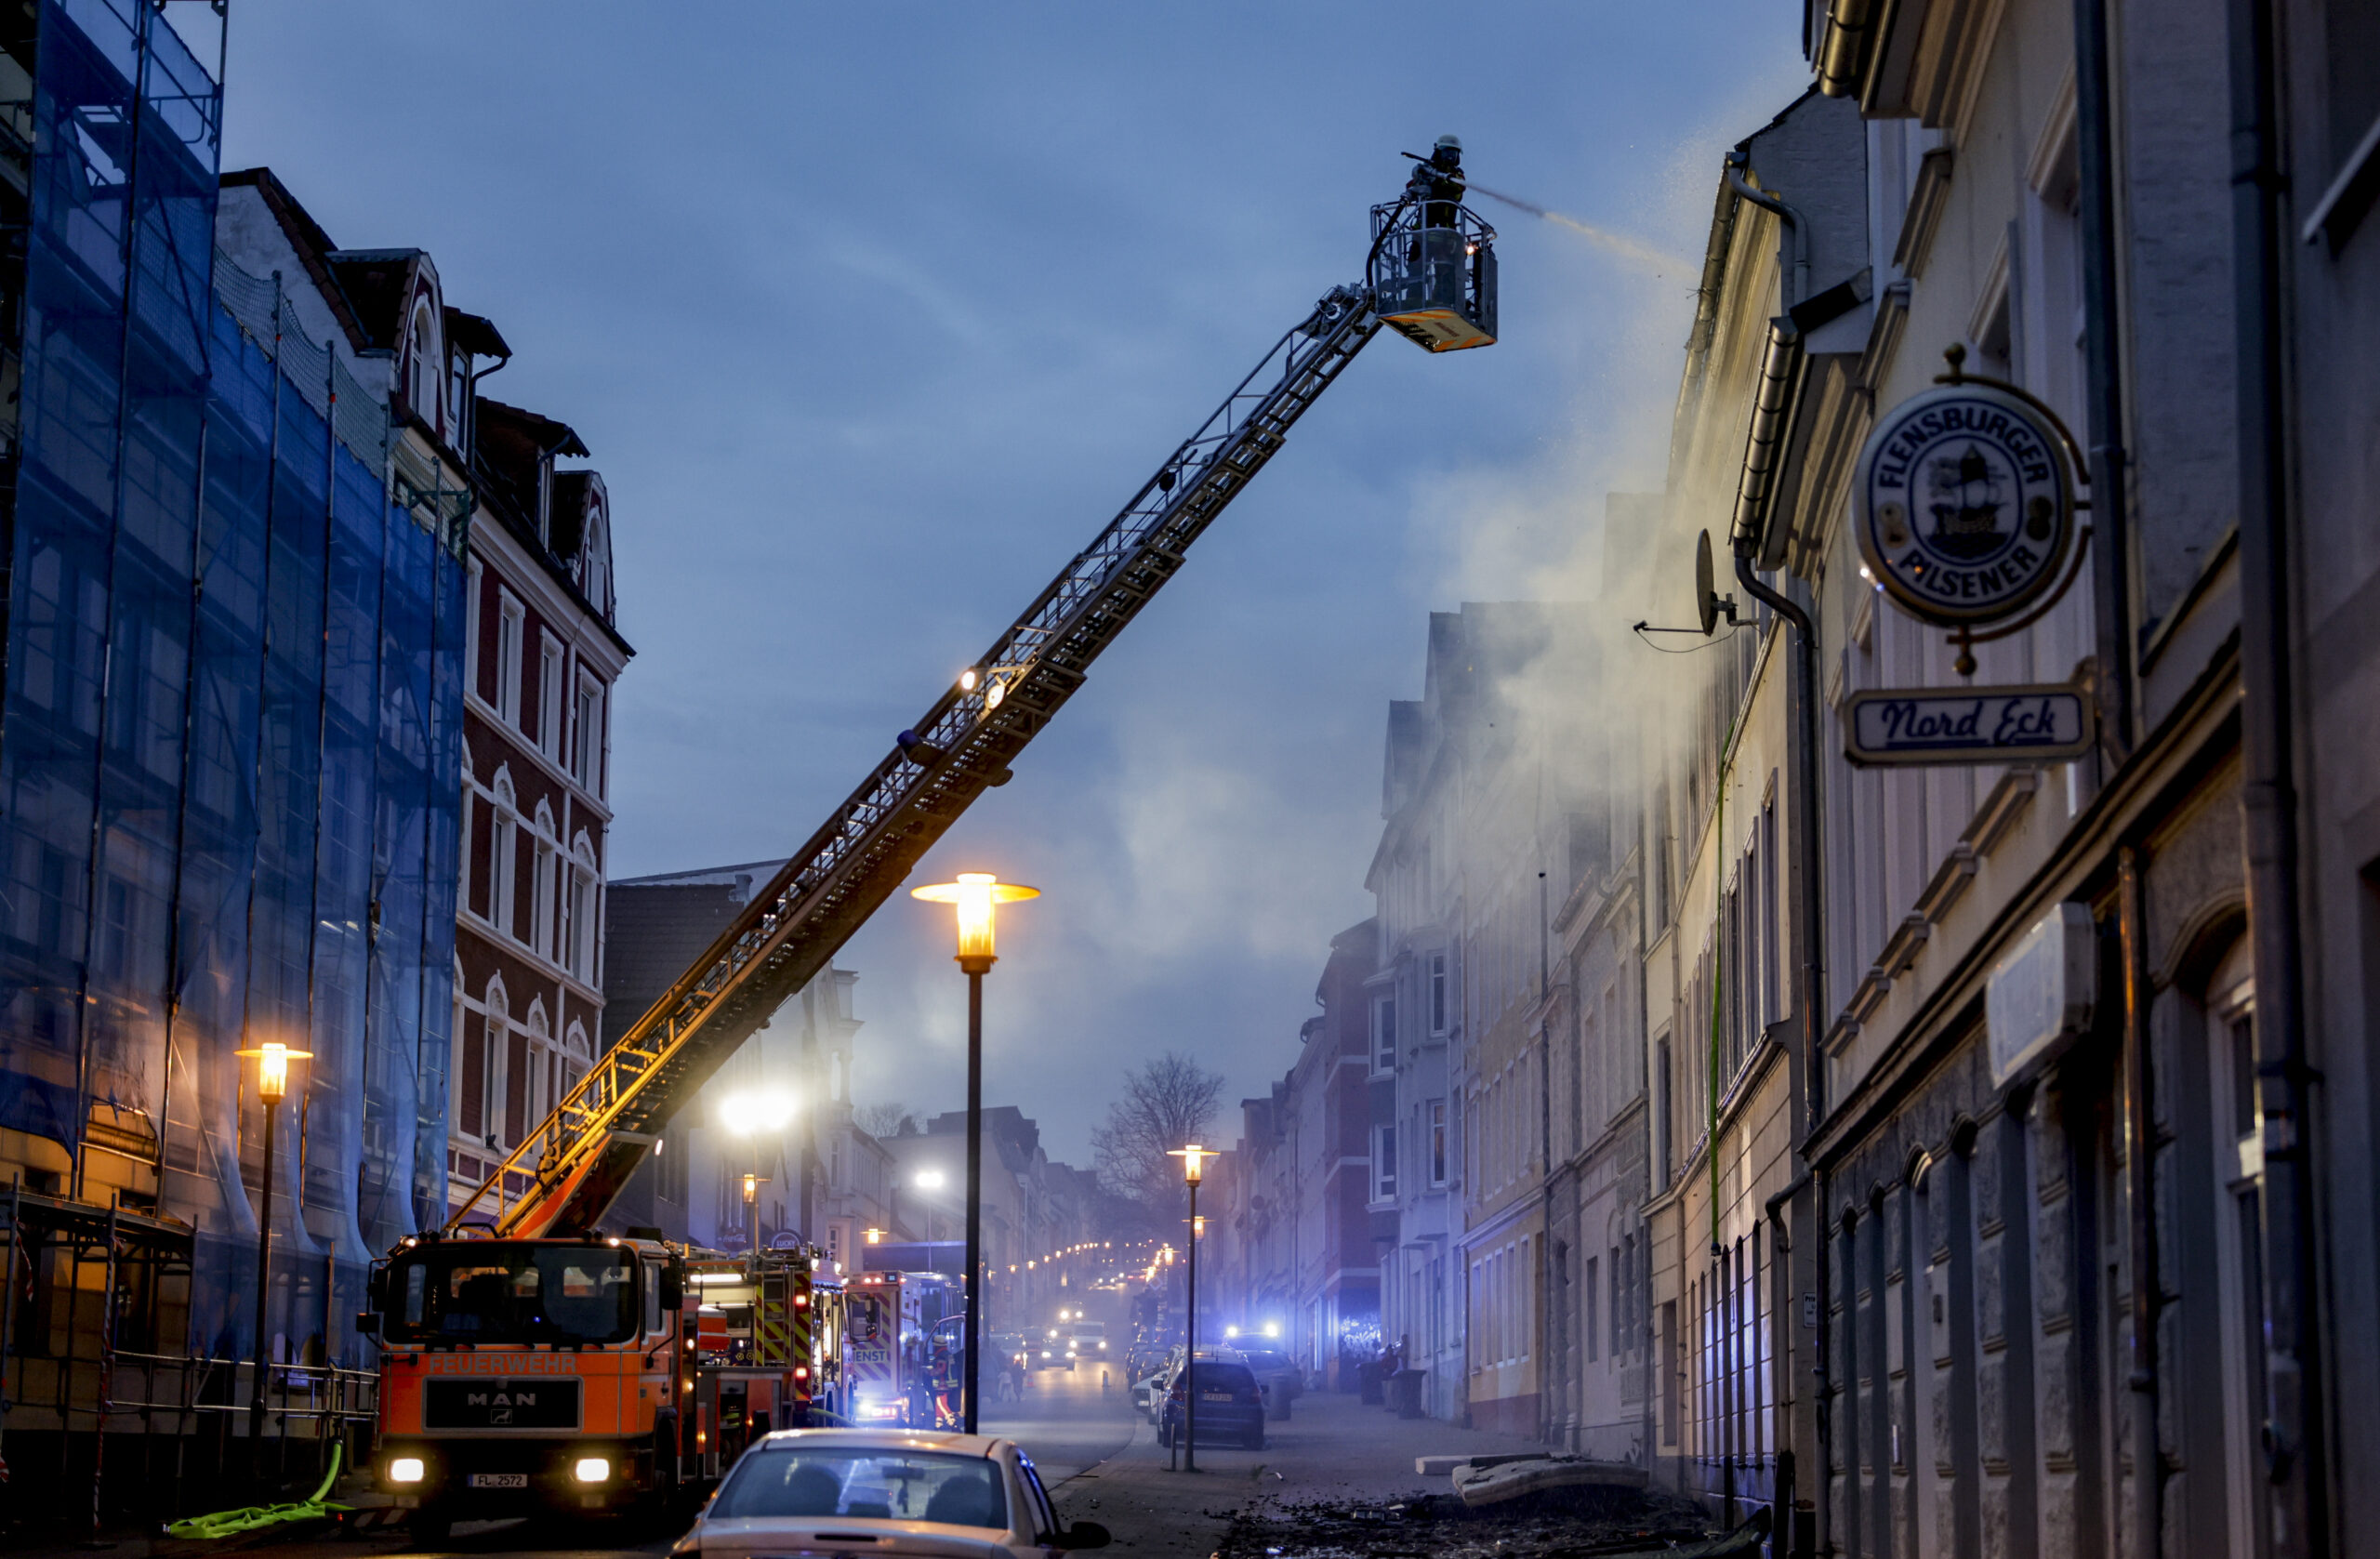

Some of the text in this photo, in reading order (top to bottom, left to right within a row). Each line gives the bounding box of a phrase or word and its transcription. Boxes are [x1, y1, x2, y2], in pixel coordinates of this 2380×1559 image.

[1879, 407, 2049, 488] FLENSBURGER
[1899, 546, 2038, 598] PILSENER
[1882, 698, 2055, 746] Nord Eck
[430, 1355, 577, 1373] FEUERWEHR
[467, 1393, 536, 1407] MAN
[478, 1475, 522, 1486] FL 2572
